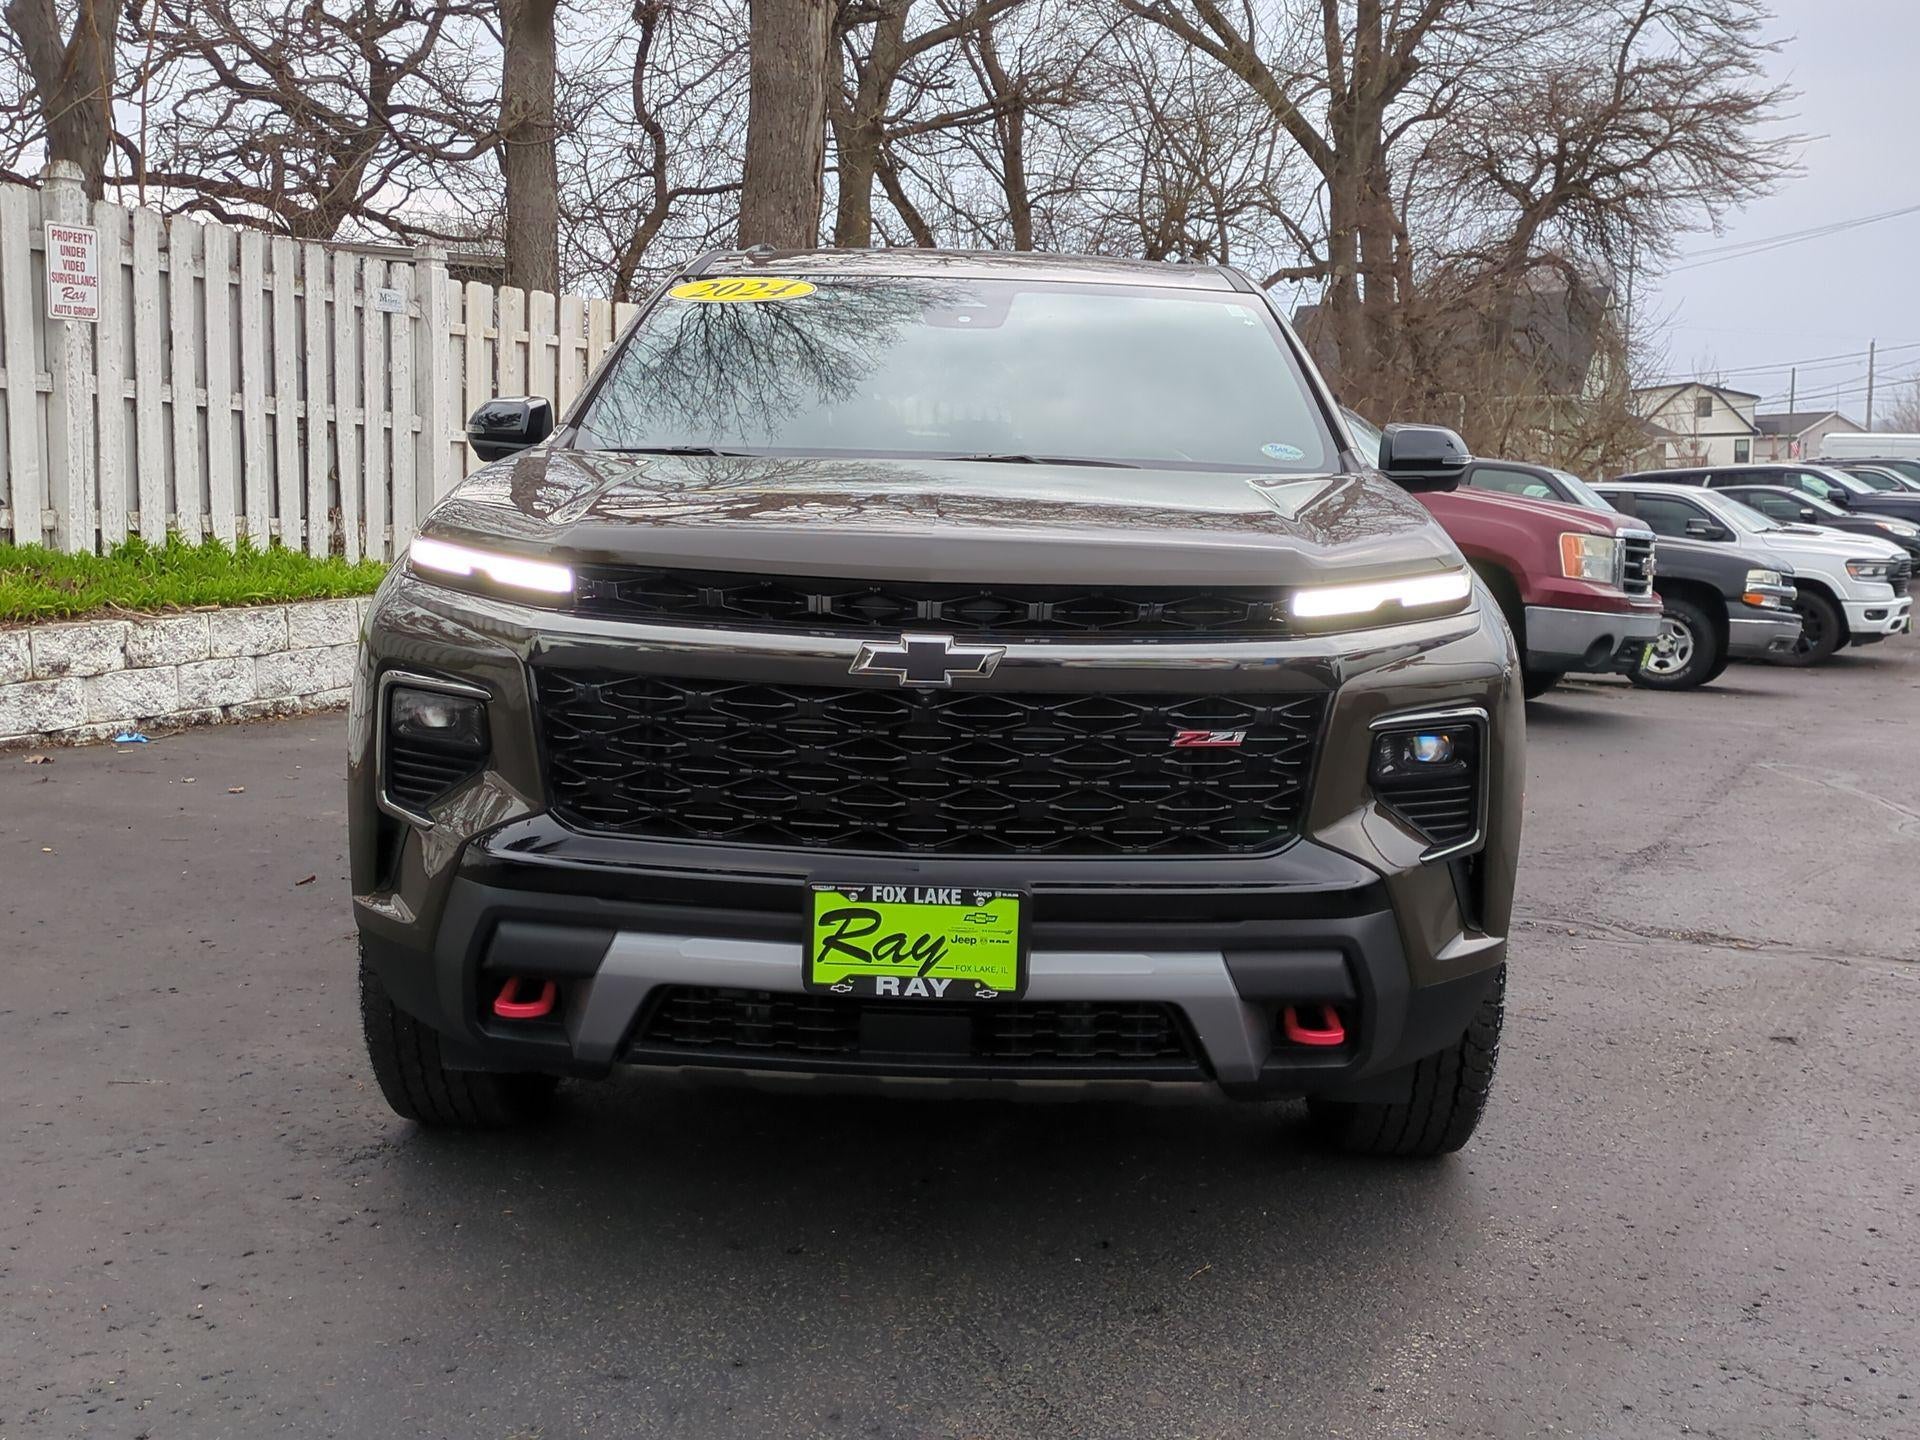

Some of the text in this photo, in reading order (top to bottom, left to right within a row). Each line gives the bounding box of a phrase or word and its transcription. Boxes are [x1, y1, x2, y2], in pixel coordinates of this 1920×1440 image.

[51, 229, 93, 245] PROPERTY
[60, 244, 86, 258] UNDER
[62, 259, 85, 272] VIDEO
[51, 271, 97, 287] SURVEILLANCE
[61, 286, 87, 303] Ray
[685, 281, 798, 298] 2024
[54, 304, 96, 316] AUTO GROUP
[872, 885, 962, 905] FOX LAKE
[973, 889, 993, 898] Jeep
[816, 907, 949, 977] Ray
[950, 934, 977, 946] Jeep
[955, 964, 1008, 974] FOX LAKE, IL
[875, 976, 953, 998] RAY
